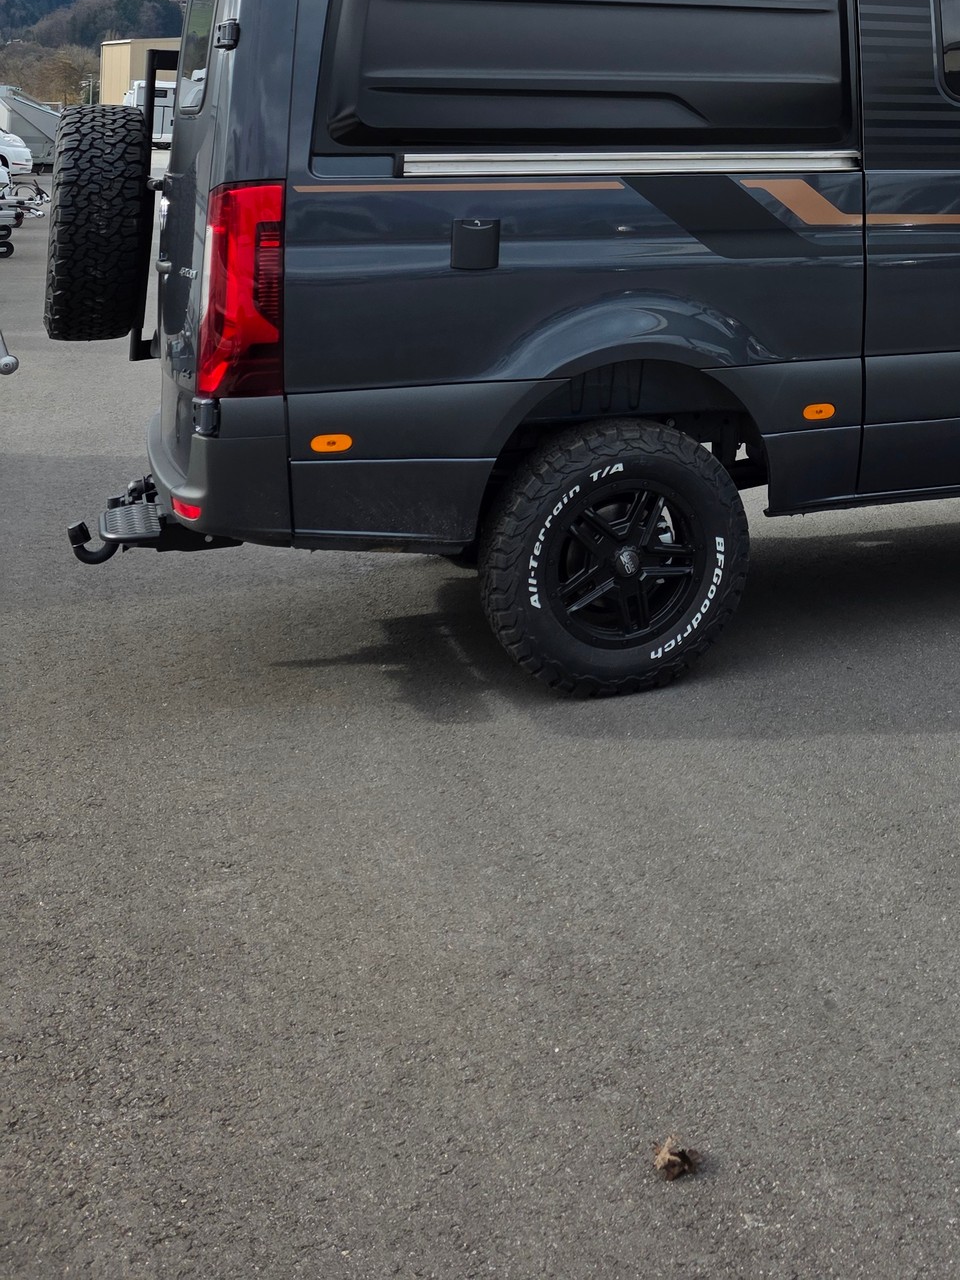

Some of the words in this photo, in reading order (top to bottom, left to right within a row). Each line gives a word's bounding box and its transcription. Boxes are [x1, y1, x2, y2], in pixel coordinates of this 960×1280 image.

[528, 484, 580, 609] All-Terrain
[590, 462, 625, 482] T/A
[650, 536, 725, 661] BFGoodrich
